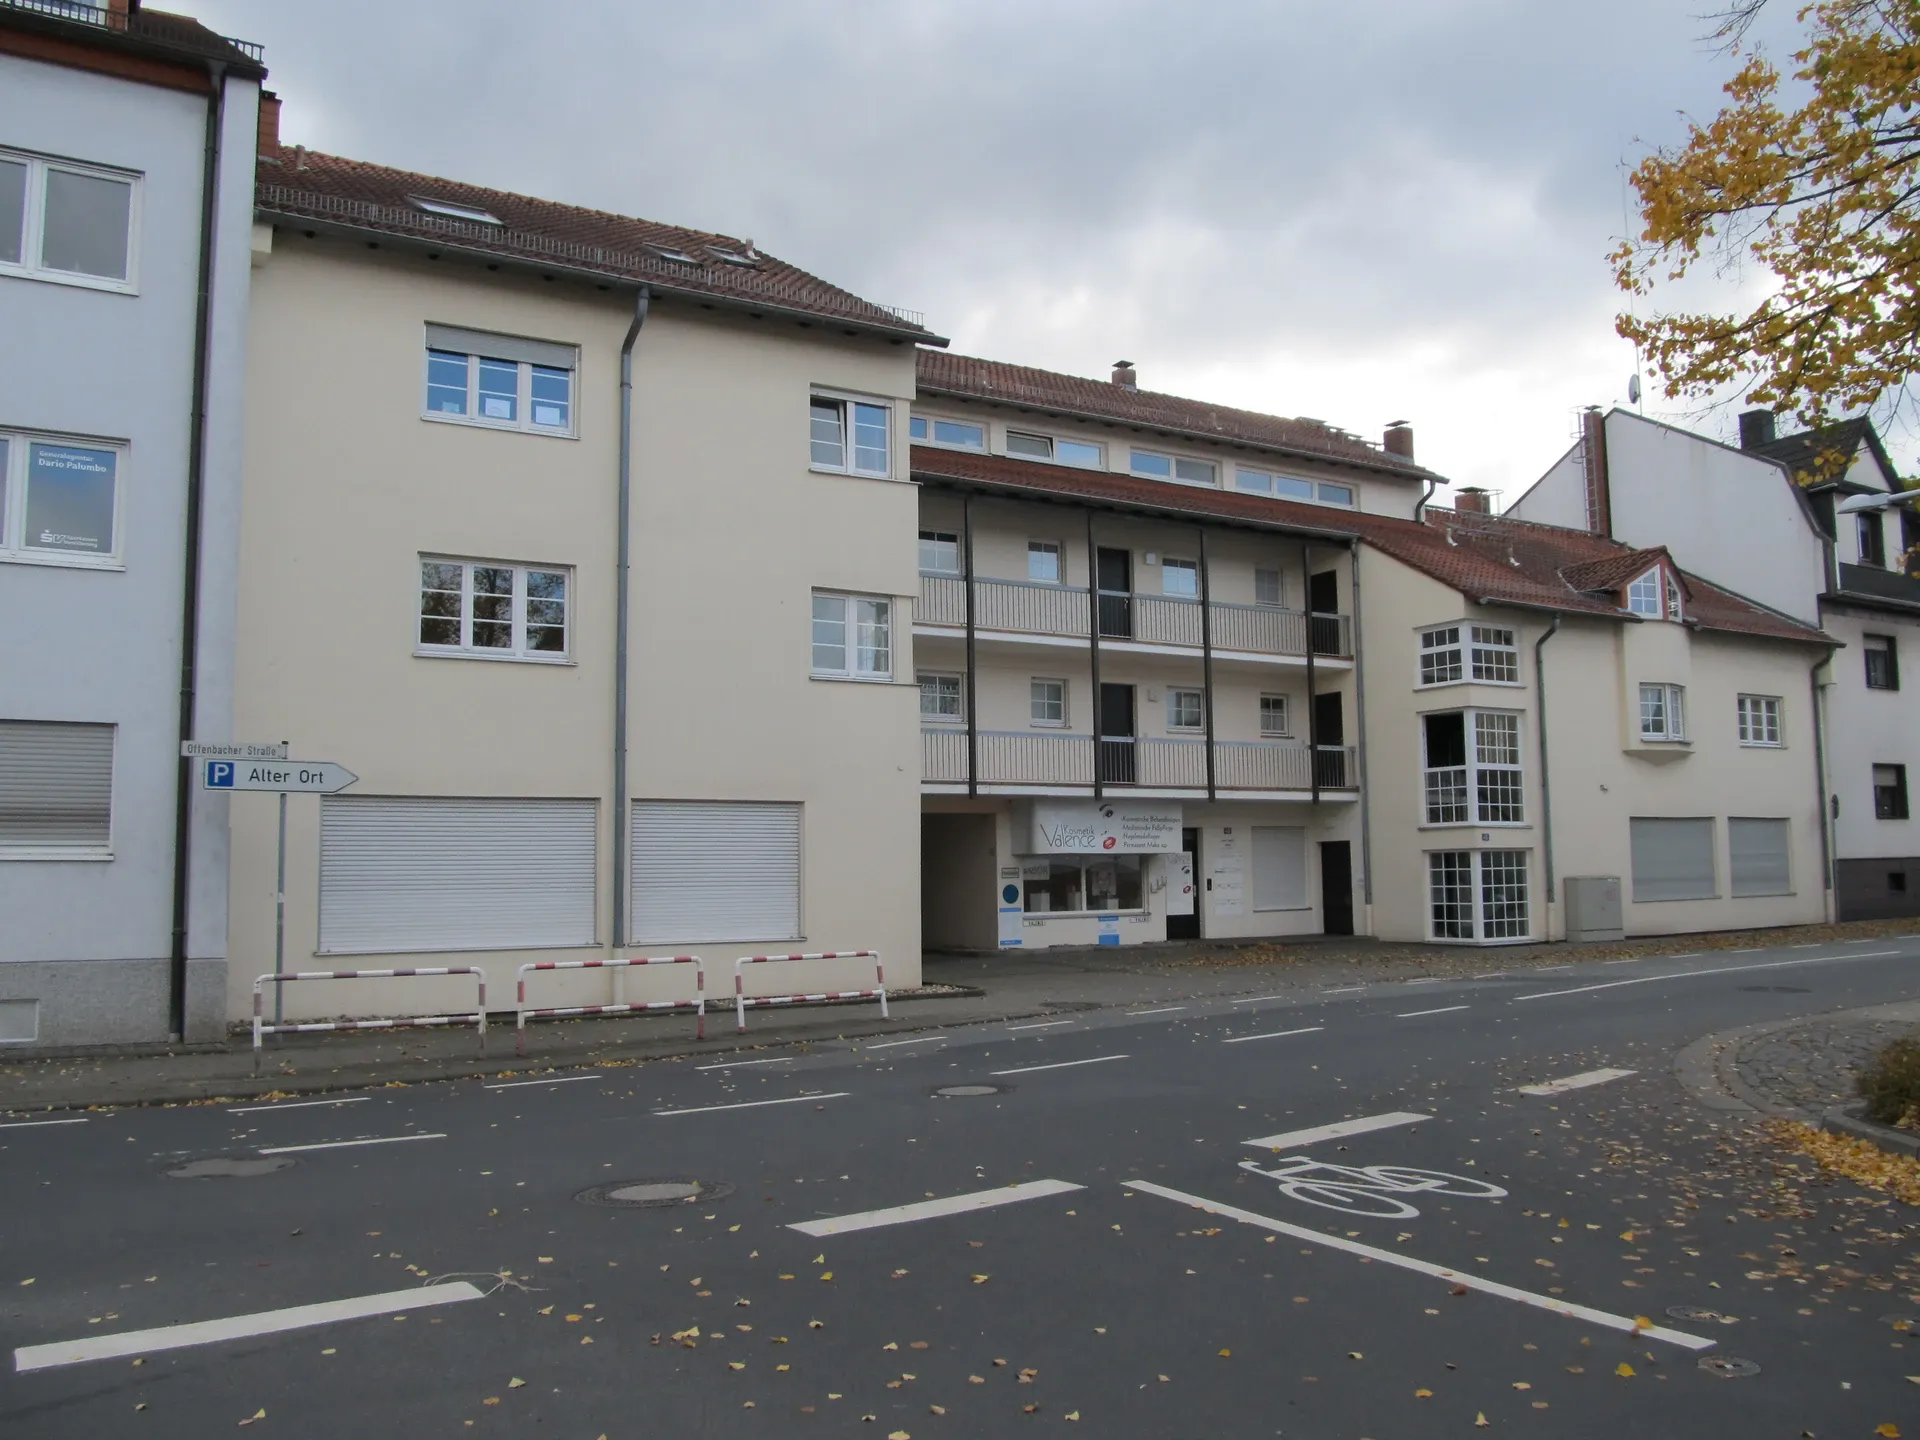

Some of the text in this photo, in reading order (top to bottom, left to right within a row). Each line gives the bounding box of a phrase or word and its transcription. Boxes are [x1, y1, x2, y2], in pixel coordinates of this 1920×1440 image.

[38, 458, 107, 473] Dario Palumbo
[187, 743, 277, 756] Offenbacher Straße
[248, 768, 291, 783] Alter
[299, 769, 324, 784] Ort
[1039, 823, 1096, 848] Valence
[1062, 824, 1095, 835] Kosmetik
